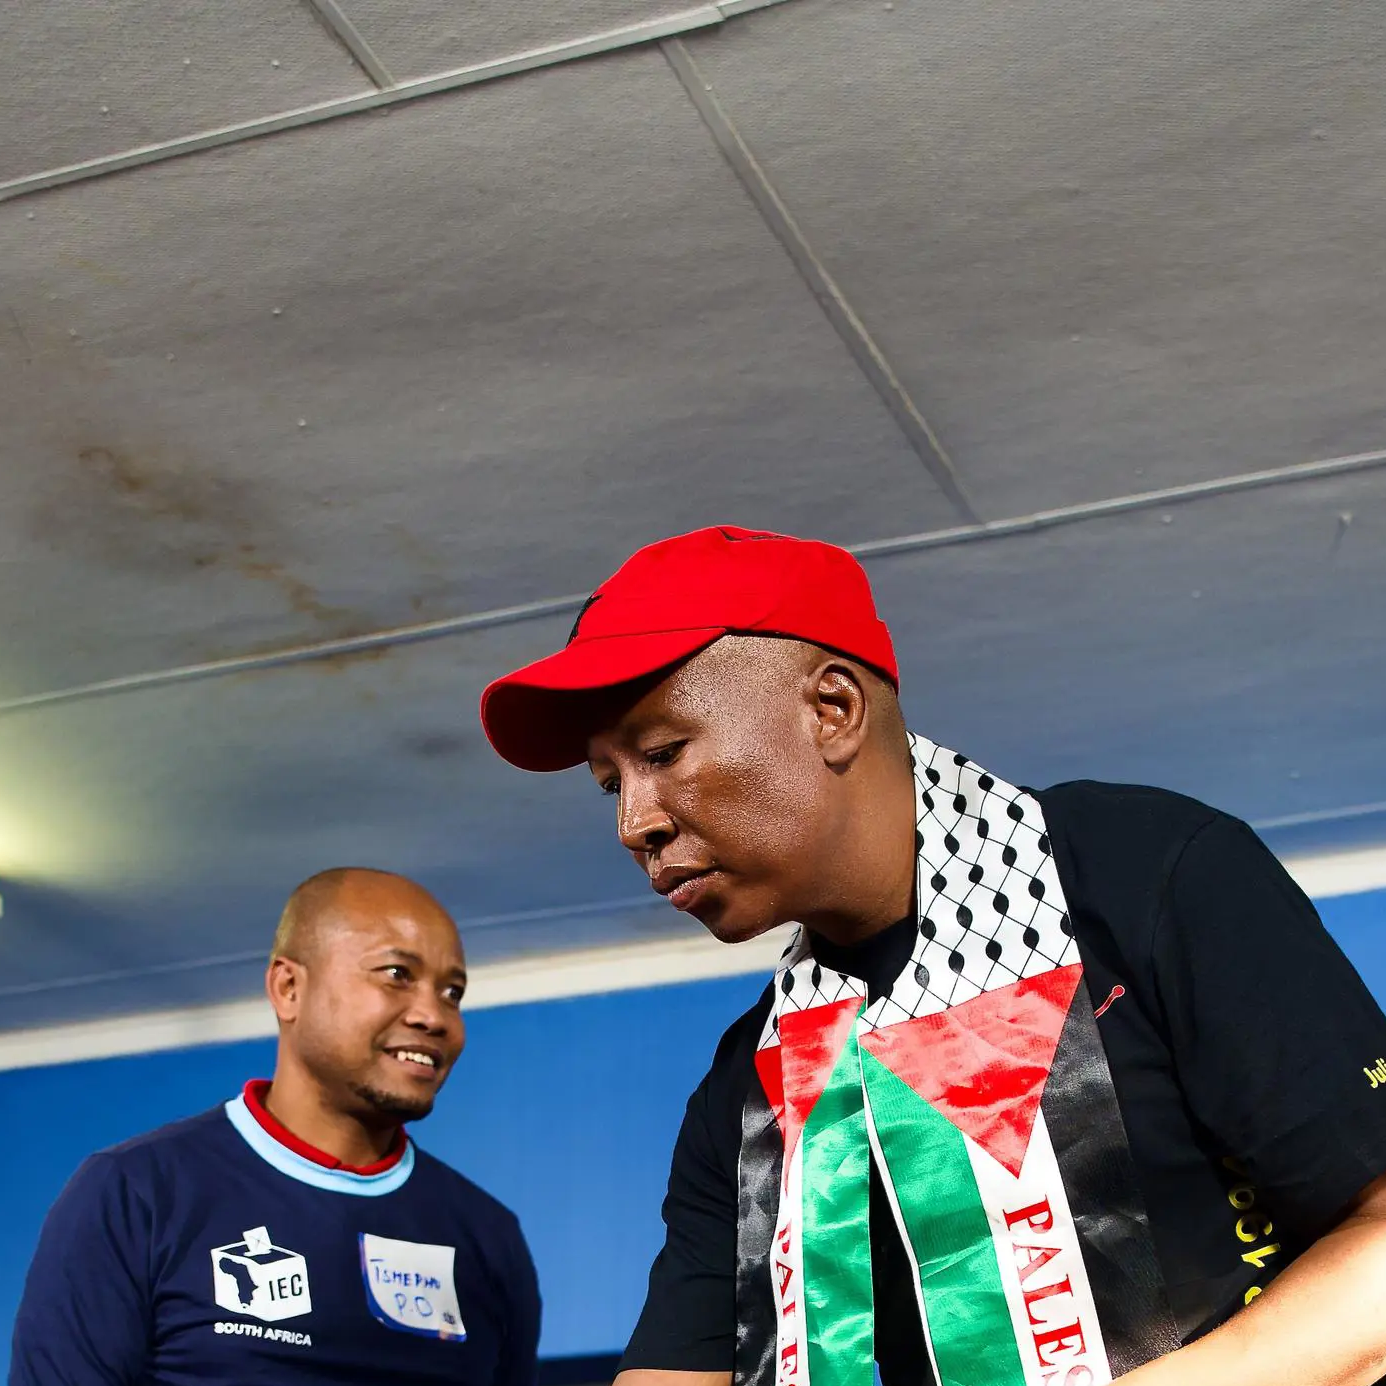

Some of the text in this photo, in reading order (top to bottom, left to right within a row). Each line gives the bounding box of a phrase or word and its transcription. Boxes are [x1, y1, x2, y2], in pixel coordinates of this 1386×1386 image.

[268, 1273, 303, 1302] IEC
[213, 1321, 312, 1346] SOUTH AFRICA
